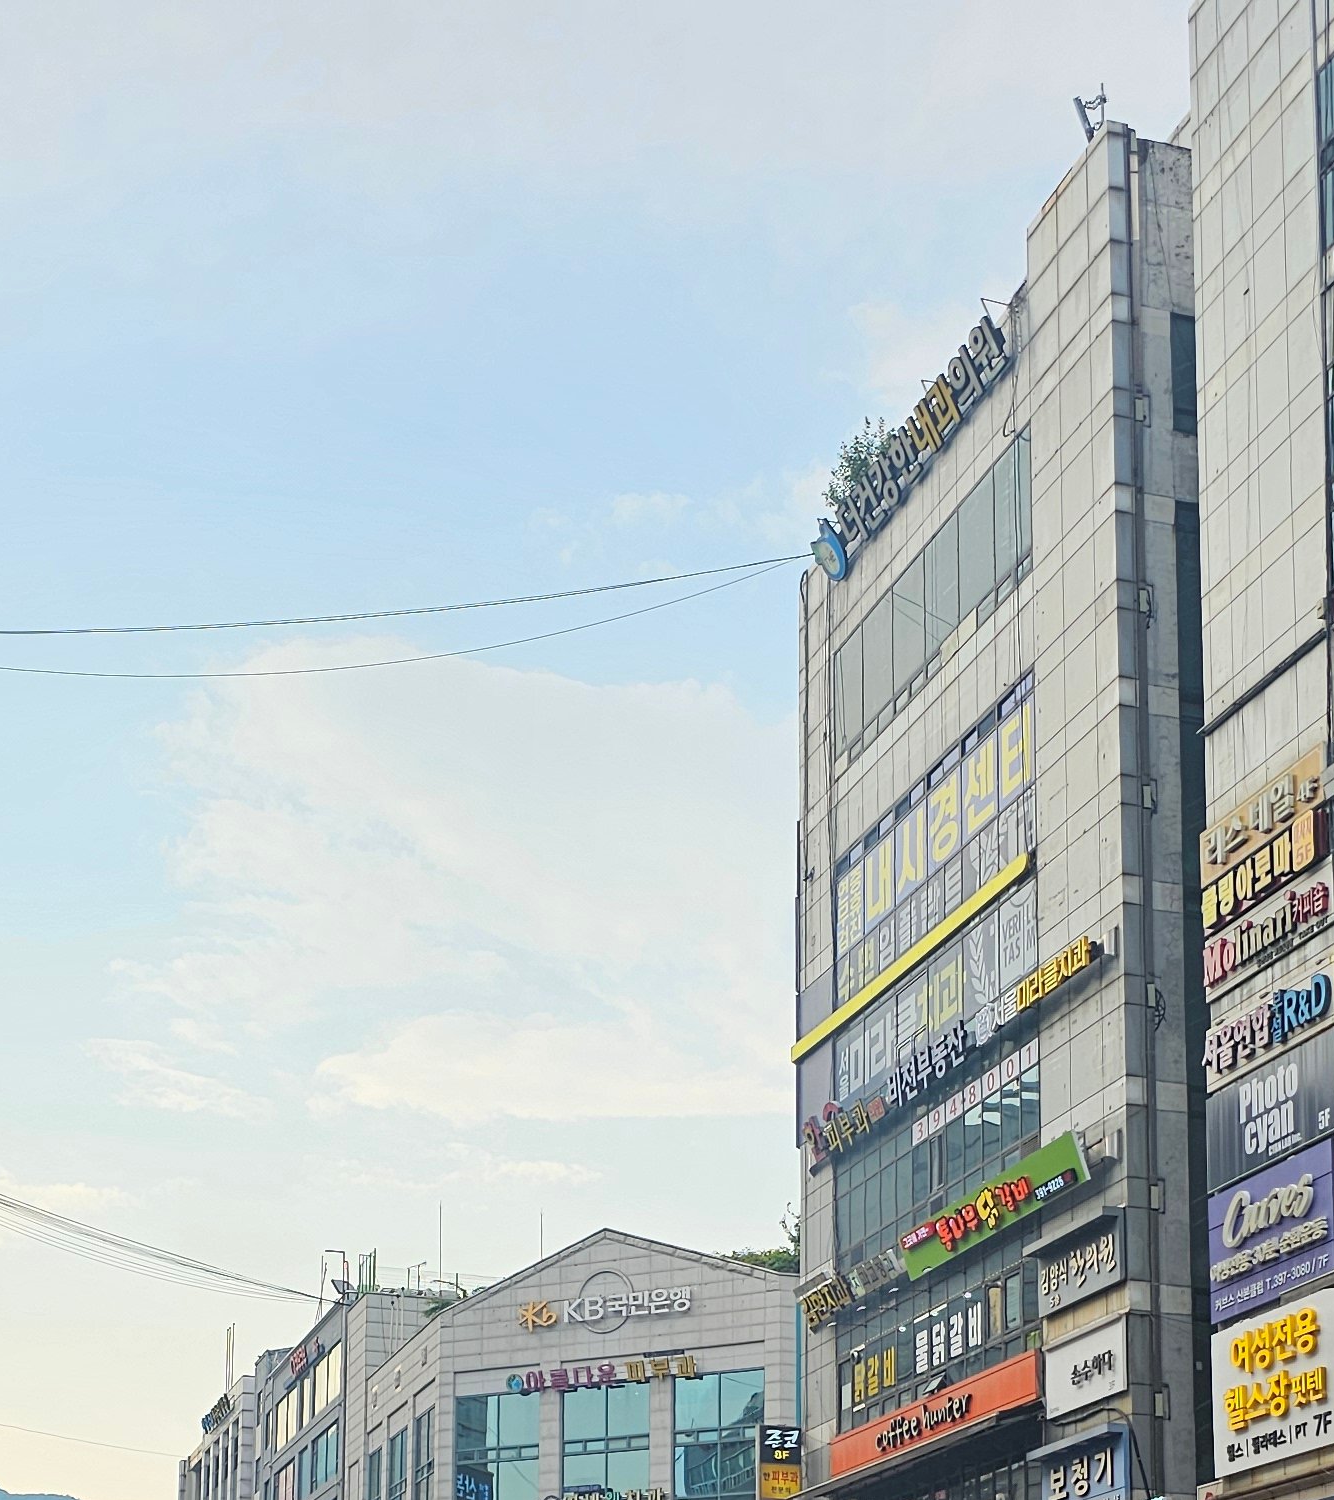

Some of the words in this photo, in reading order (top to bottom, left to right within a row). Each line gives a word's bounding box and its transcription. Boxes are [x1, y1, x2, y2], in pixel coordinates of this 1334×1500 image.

[865, 700, 1032, 923] 내시경센터
[1202, 888, 1293, 989] Molinari
[1283, 972, 1331, 1033] R&D
[884, 1019, 969, 1109] 비전부동산
[1238, 1062, 1299, 1125] Photo
[1243, 1099, 1296, 1156] cyan
[1317, 1107, 1331, 1131] 5F
[1221, 1172, 1315, 1250] Curves
[563, 1285, 692, 1325] KB국민은행
[1040, 1263, 1068, 1295] 김양식
[1229, 1306, 1321, 1374] 여성전용
[524, 1361, 618, 1394] 아름다운
[623, 1354, 698, 1383] 피부과
[1222, 1370, 1290, 1432] 헬스장
[1288, 1365, 1327, 1408] 핏텐
[875, 1413, 919, 1453] coffee
[921, 1392, 974, 1438] hunter
[1312, 1410, 1333, 1437] 7F
